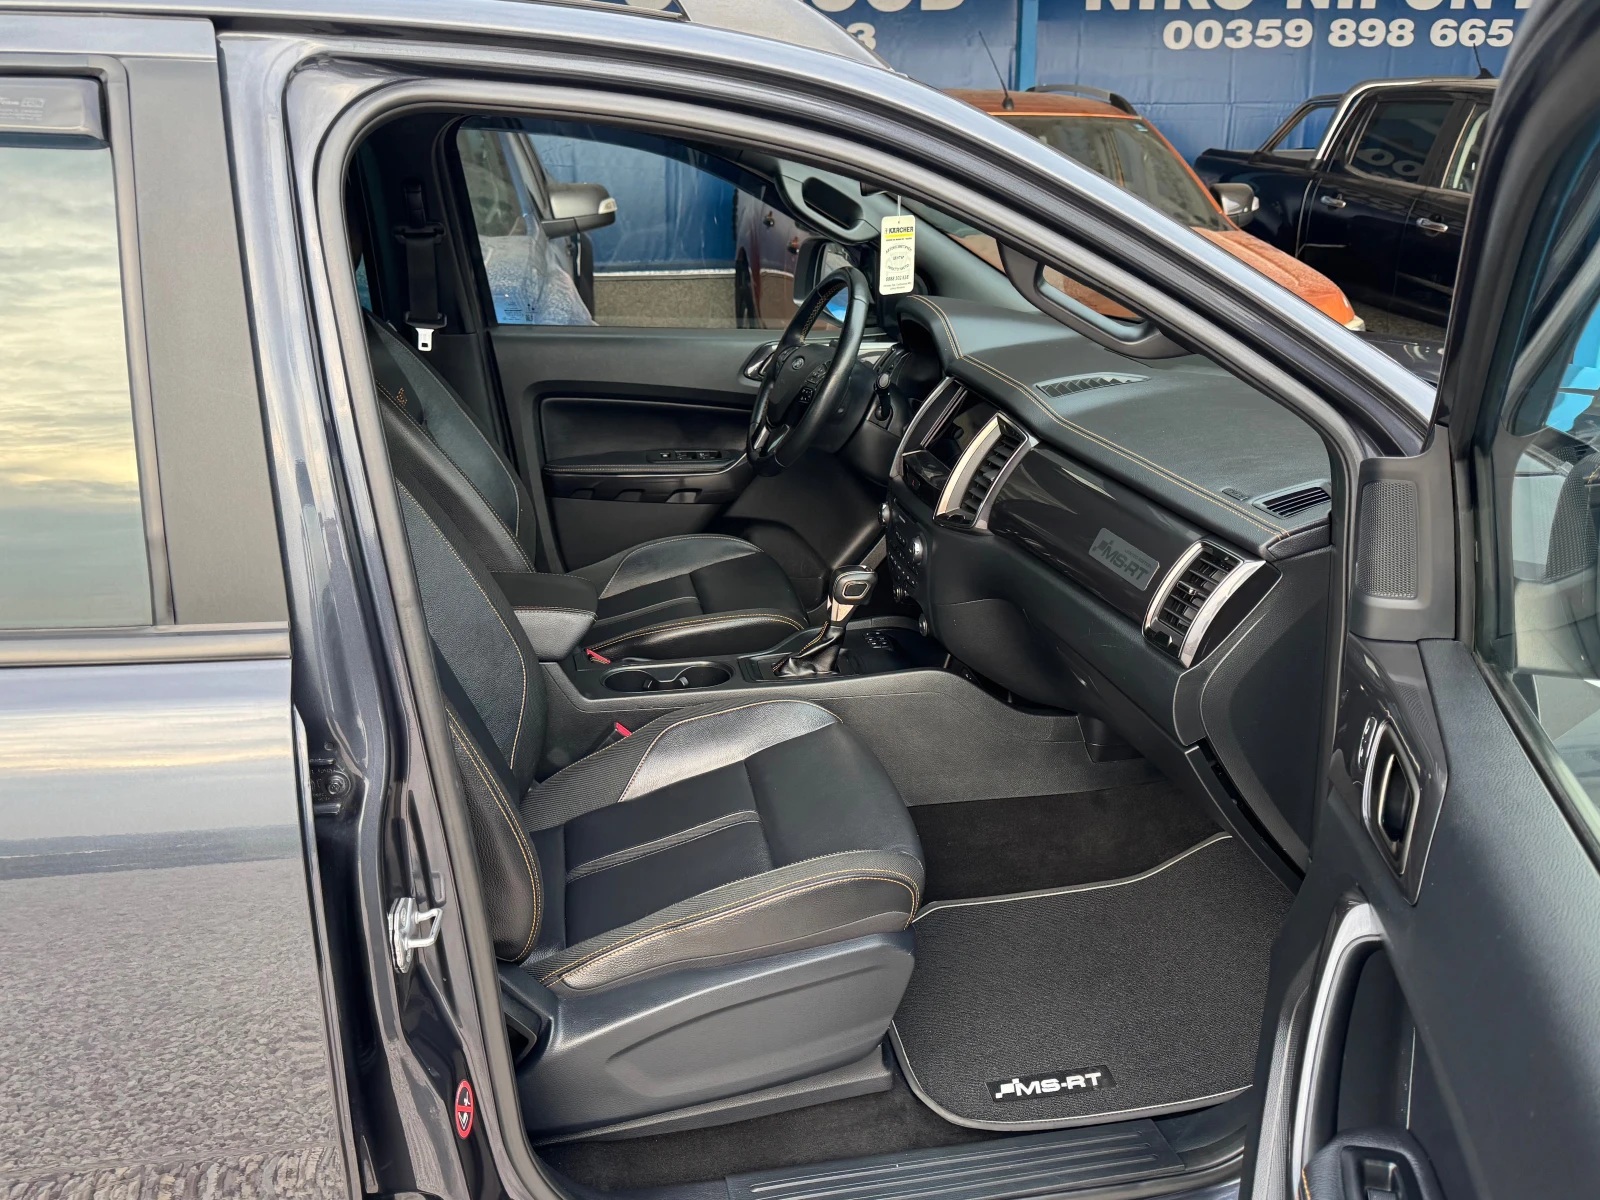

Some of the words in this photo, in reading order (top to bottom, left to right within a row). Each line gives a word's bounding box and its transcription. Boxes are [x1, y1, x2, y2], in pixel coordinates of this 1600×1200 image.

[1163, 18, 1313, 50] 00359
[1328, 18, 1415, 48] 898
[1430, 18, 1514, 48] 665
[1016, 1072, 1102, 1097] MS-RT
